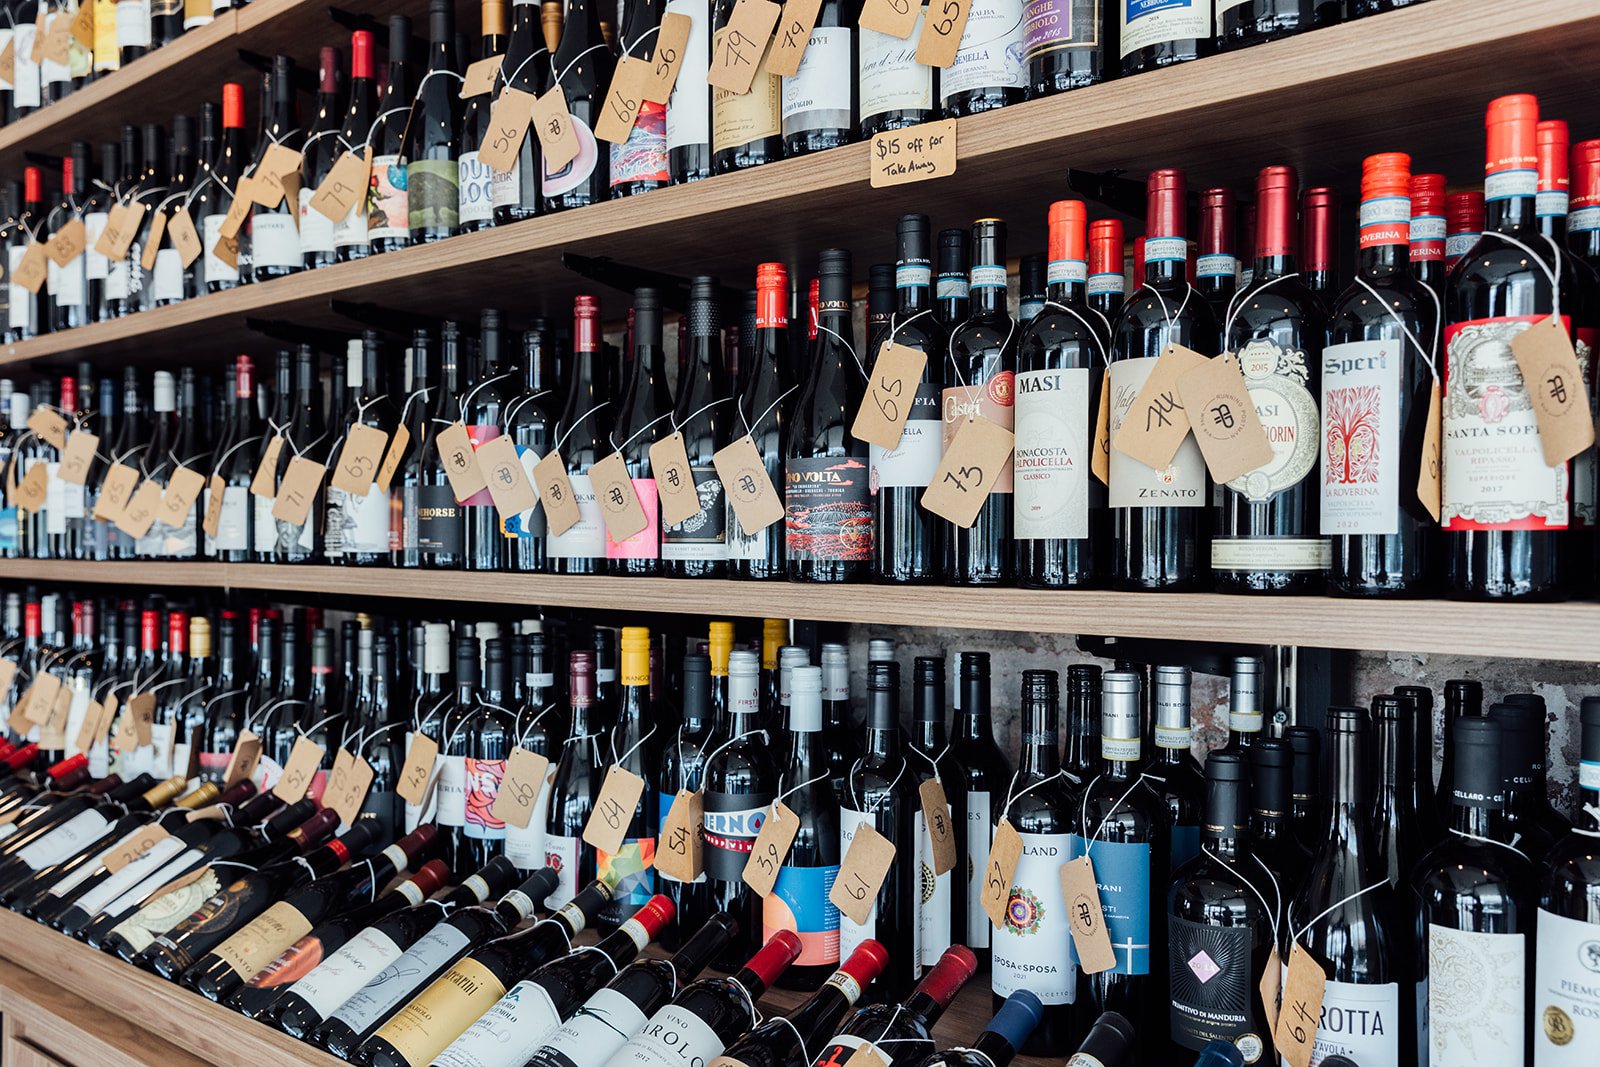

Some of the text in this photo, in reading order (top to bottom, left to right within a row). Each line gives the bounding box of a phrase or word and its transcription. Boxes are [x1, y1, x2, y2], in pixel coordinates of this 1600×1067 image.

[933, 1, 960, 36] 65
[782, 21, 805, 49] 79
[725, 30, 757, 68] 79
[656, 48, 677, 81] 56
[611, 90, 637, 124] 66
[493, 127, 518, 155] 56
[876, 135, 945, 161] $15 off for
[321, 182, 355, 208] 79
[1251, 363, 1269, 373] 2015
[1325, 350, 1387, 375] Speri
[1019, 375, 1061, 395] MASI
[873, 377, 902, 423] 65
[345, 456, 374, 478] 63
[802, 471, 842, 482] VOLTA
[943, 466, 984, 493] 73
[1139, 488, 1196, 499] ZENATO
[1333, 488, 1380, 497] ROVERINA
[600, 798, 626, 830] 64
[668, 826, 691, 855] 54
[1023, 846, 1059, 857] LAND
[844, 872, 871, 900] 61
[1022, 963, 1058, 974] SPOSA
[666, 1013, 689, 1029] VINO
[1207, 1012, 1247, 1023] MANDURIA
[1317, 1004, 1384, 1036] ROTTA
